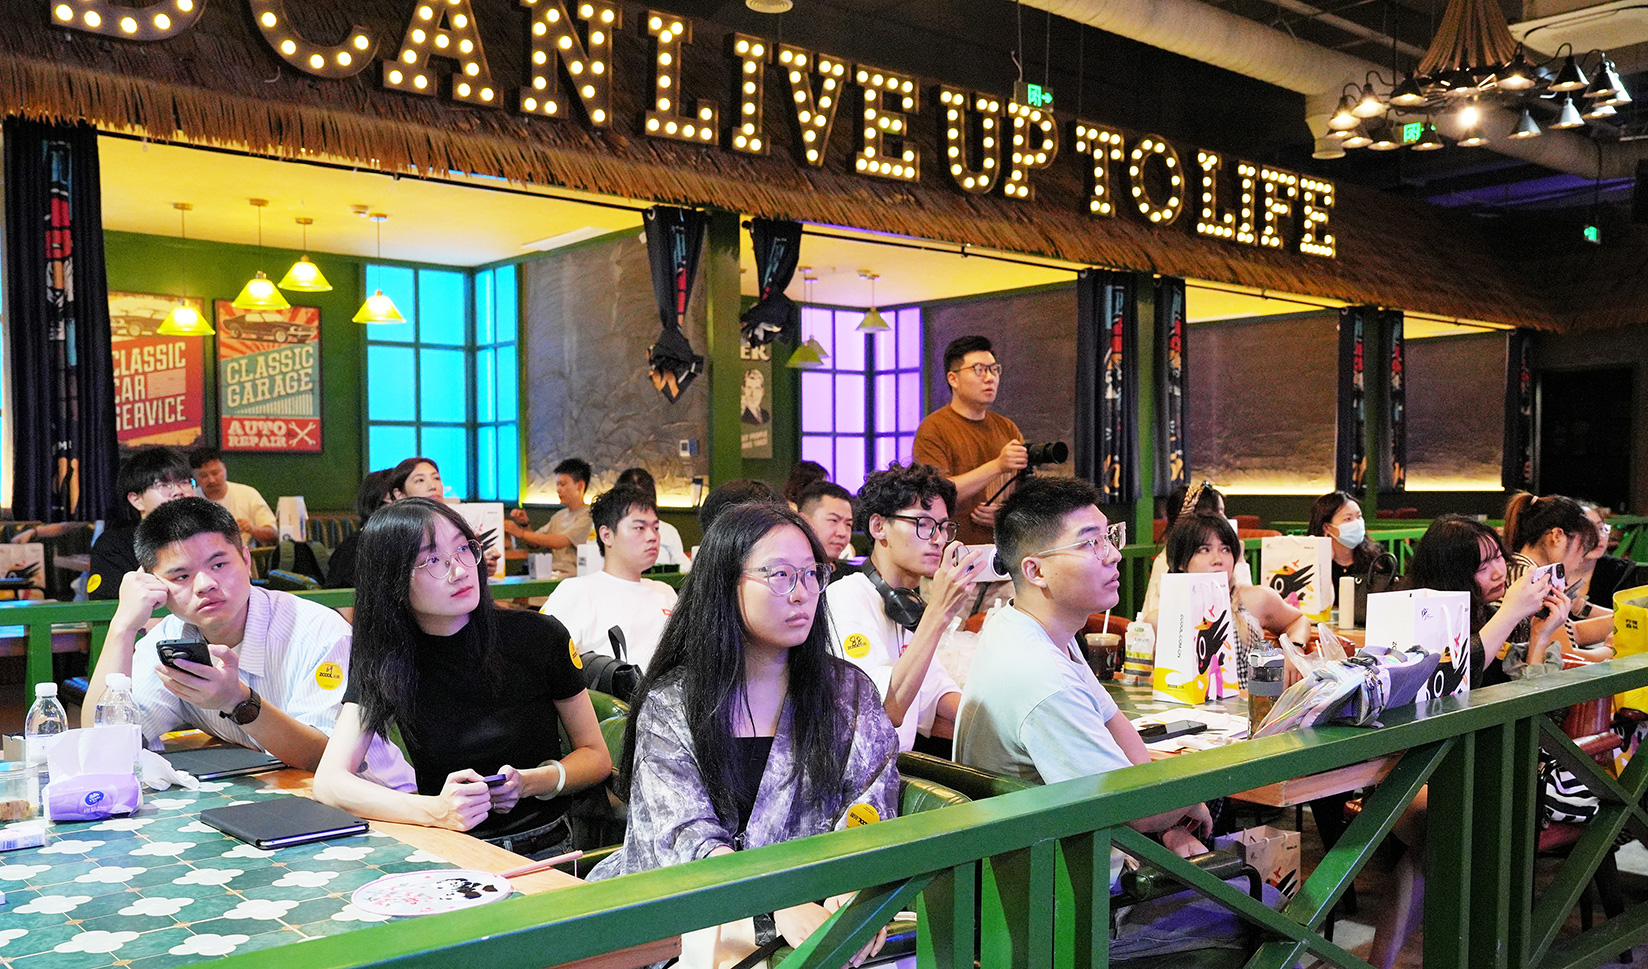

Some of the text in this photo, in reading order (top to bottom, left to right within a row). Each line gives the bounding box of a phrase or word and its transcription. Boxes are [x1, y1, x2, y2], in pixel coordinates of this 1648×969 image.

[645, 10, 922, 182] LIVE
[936, 84, 1057, 198] UP
[1076, 121, 1185, 225] TO
[1197, 150, 1338, 258] LIFE
[112, 341, 186, 377] CLASSIC
[226, 346, 314, 385] CLASSIC
[227, 368, 314, 408] GARAGE
[228, 420, 287, 436] AUTO
[228, 436, 288, 448] REPAIR
